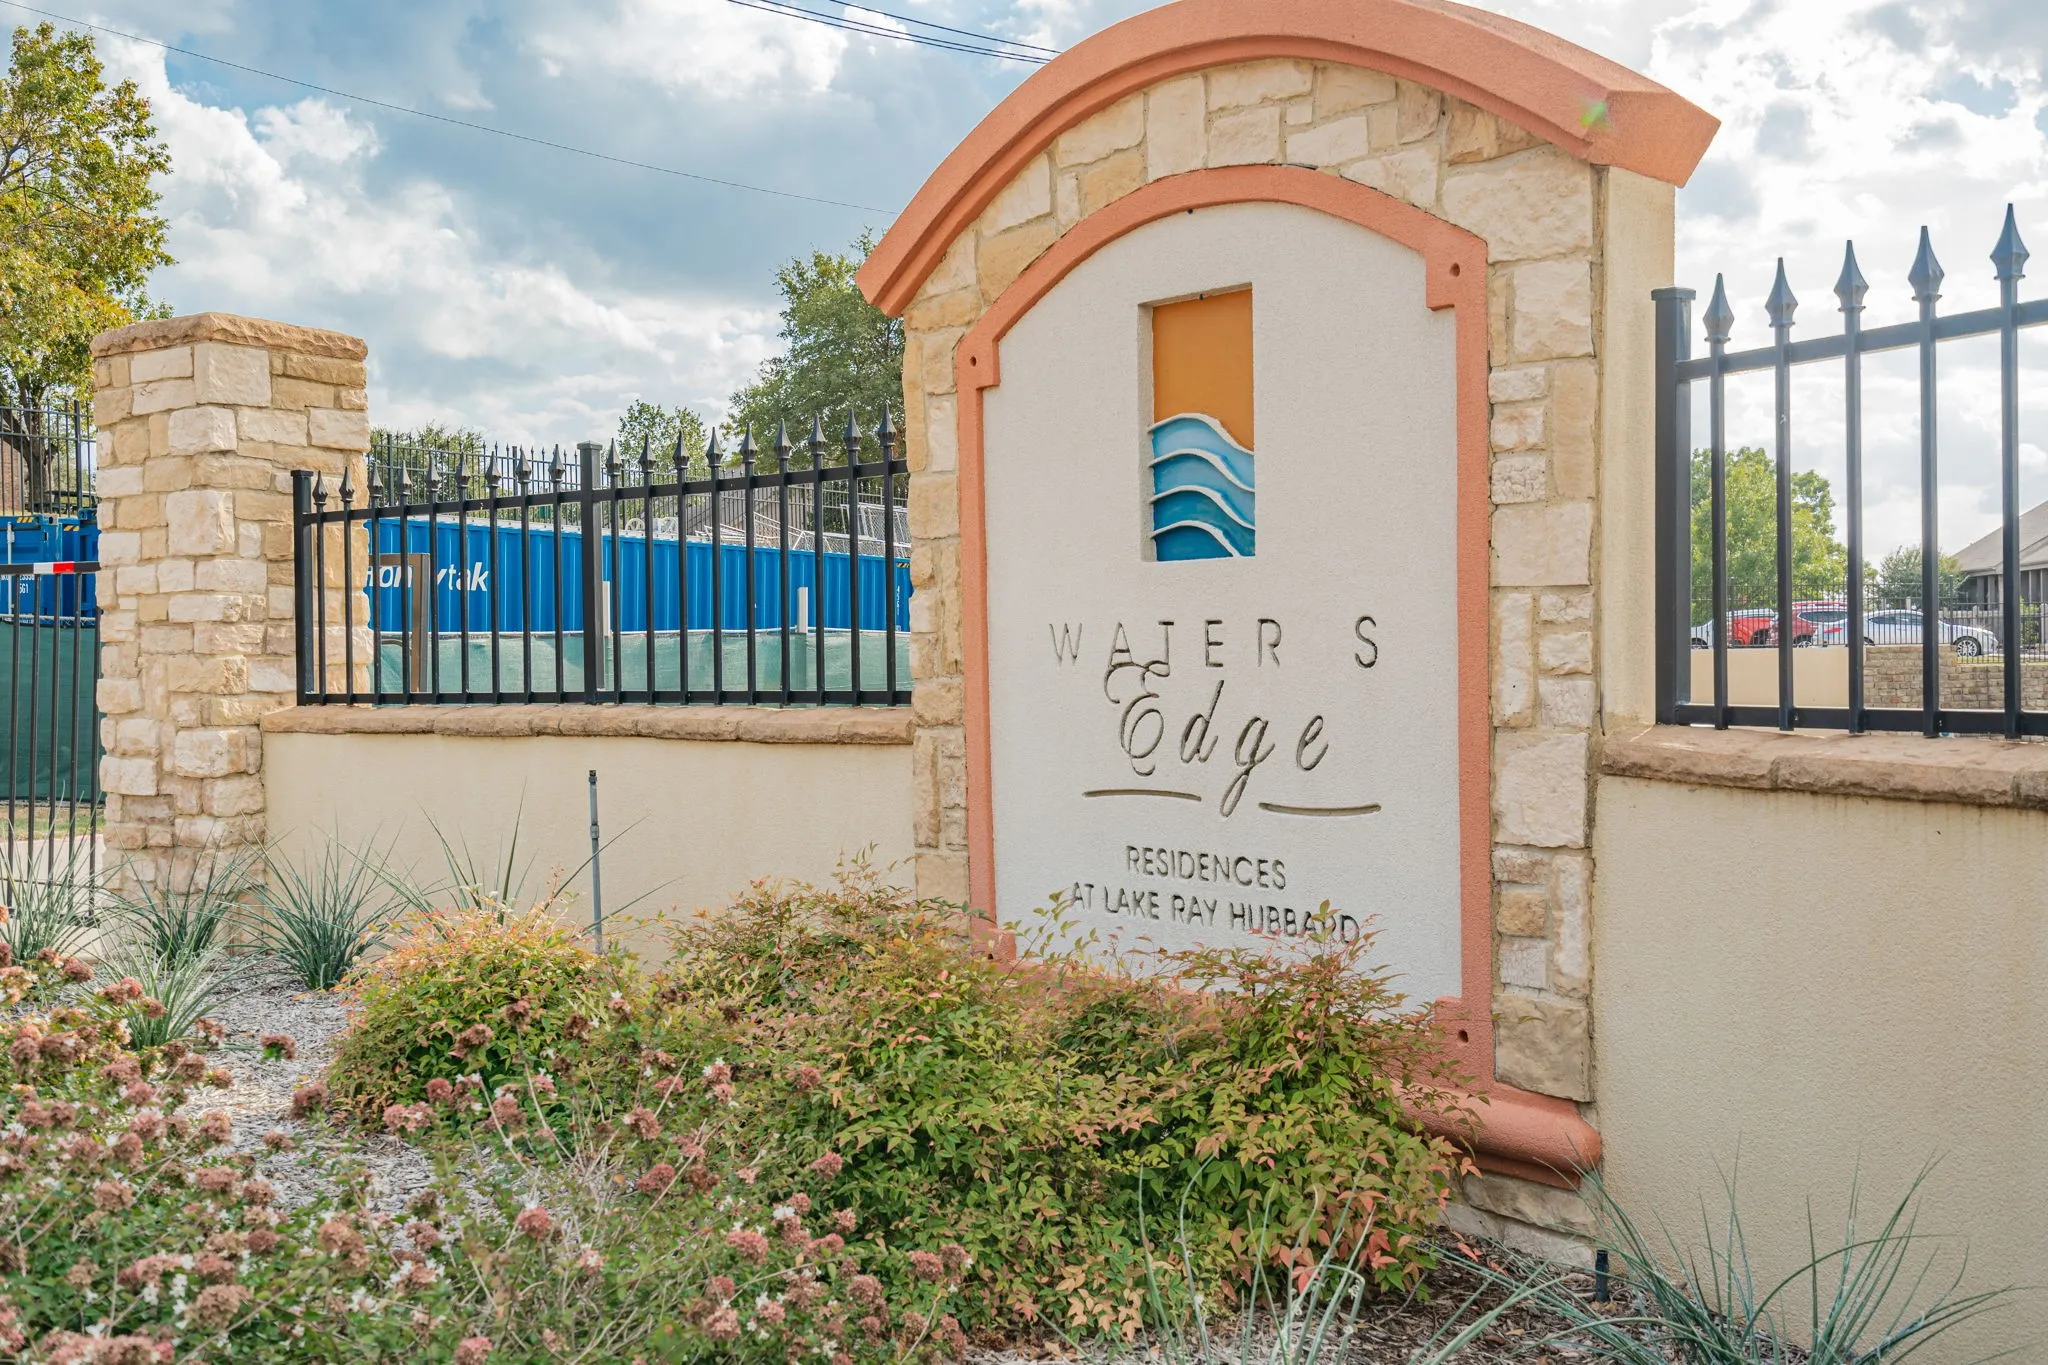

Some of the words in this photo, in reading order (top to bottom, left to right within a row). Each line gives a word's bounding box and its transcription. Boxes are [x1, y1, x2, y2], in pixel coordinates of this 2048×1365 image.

[1104, 661, 1329, 818] Edge
[1126, 845, 1287, 890] RESIDENCES
[1070, 881, 1095, 911] AT
[1104, 885, 1160, 920] LAKE
[1171, 894, 1218, 927] RAY
